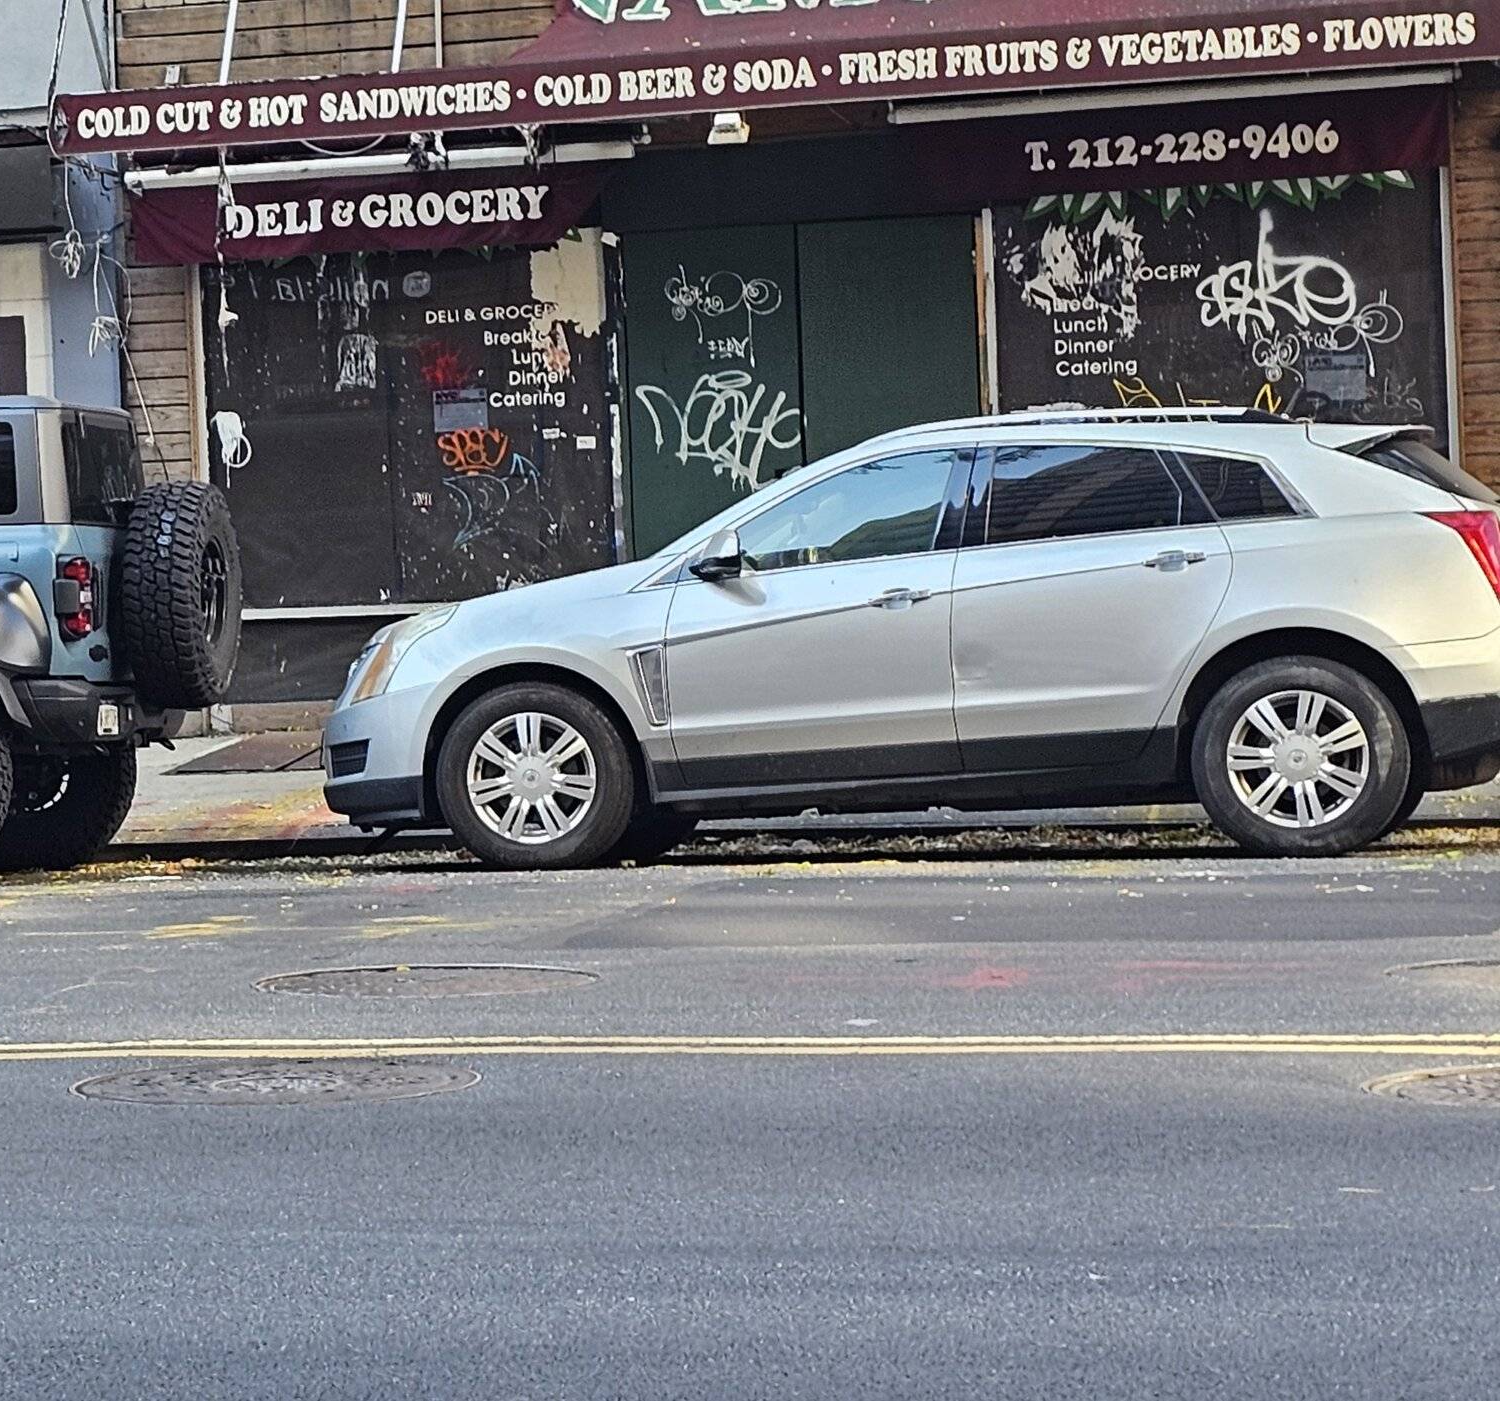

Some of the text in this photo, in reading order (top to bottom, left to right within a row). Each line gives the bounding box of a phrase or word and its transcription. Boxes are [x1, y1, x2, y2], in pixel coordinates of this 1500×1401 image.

[77, 12, 1476, 139] COLD CUT & HOT SANDWICHES COLD BEER & SODA FRESH FRUITS & VEGETABLES FLOWERS
[1025, 120, 1339, 171] T. 212-228-9406
[226, 185, 549, 239] DELI & GROCERY
[1133, 263, 1202, 281] OCERY
[425, 309, 460, 325] DELI
[464, 308, 477, 322] &
[1053, 317, 1108, 334] Lunch
[1054, 338, 1114, 355] Dinner
[1055, 357, 1138, 377] Catering
[509, 369, 564, 386] Dinner
[489, 391, 566, 408] Catering
